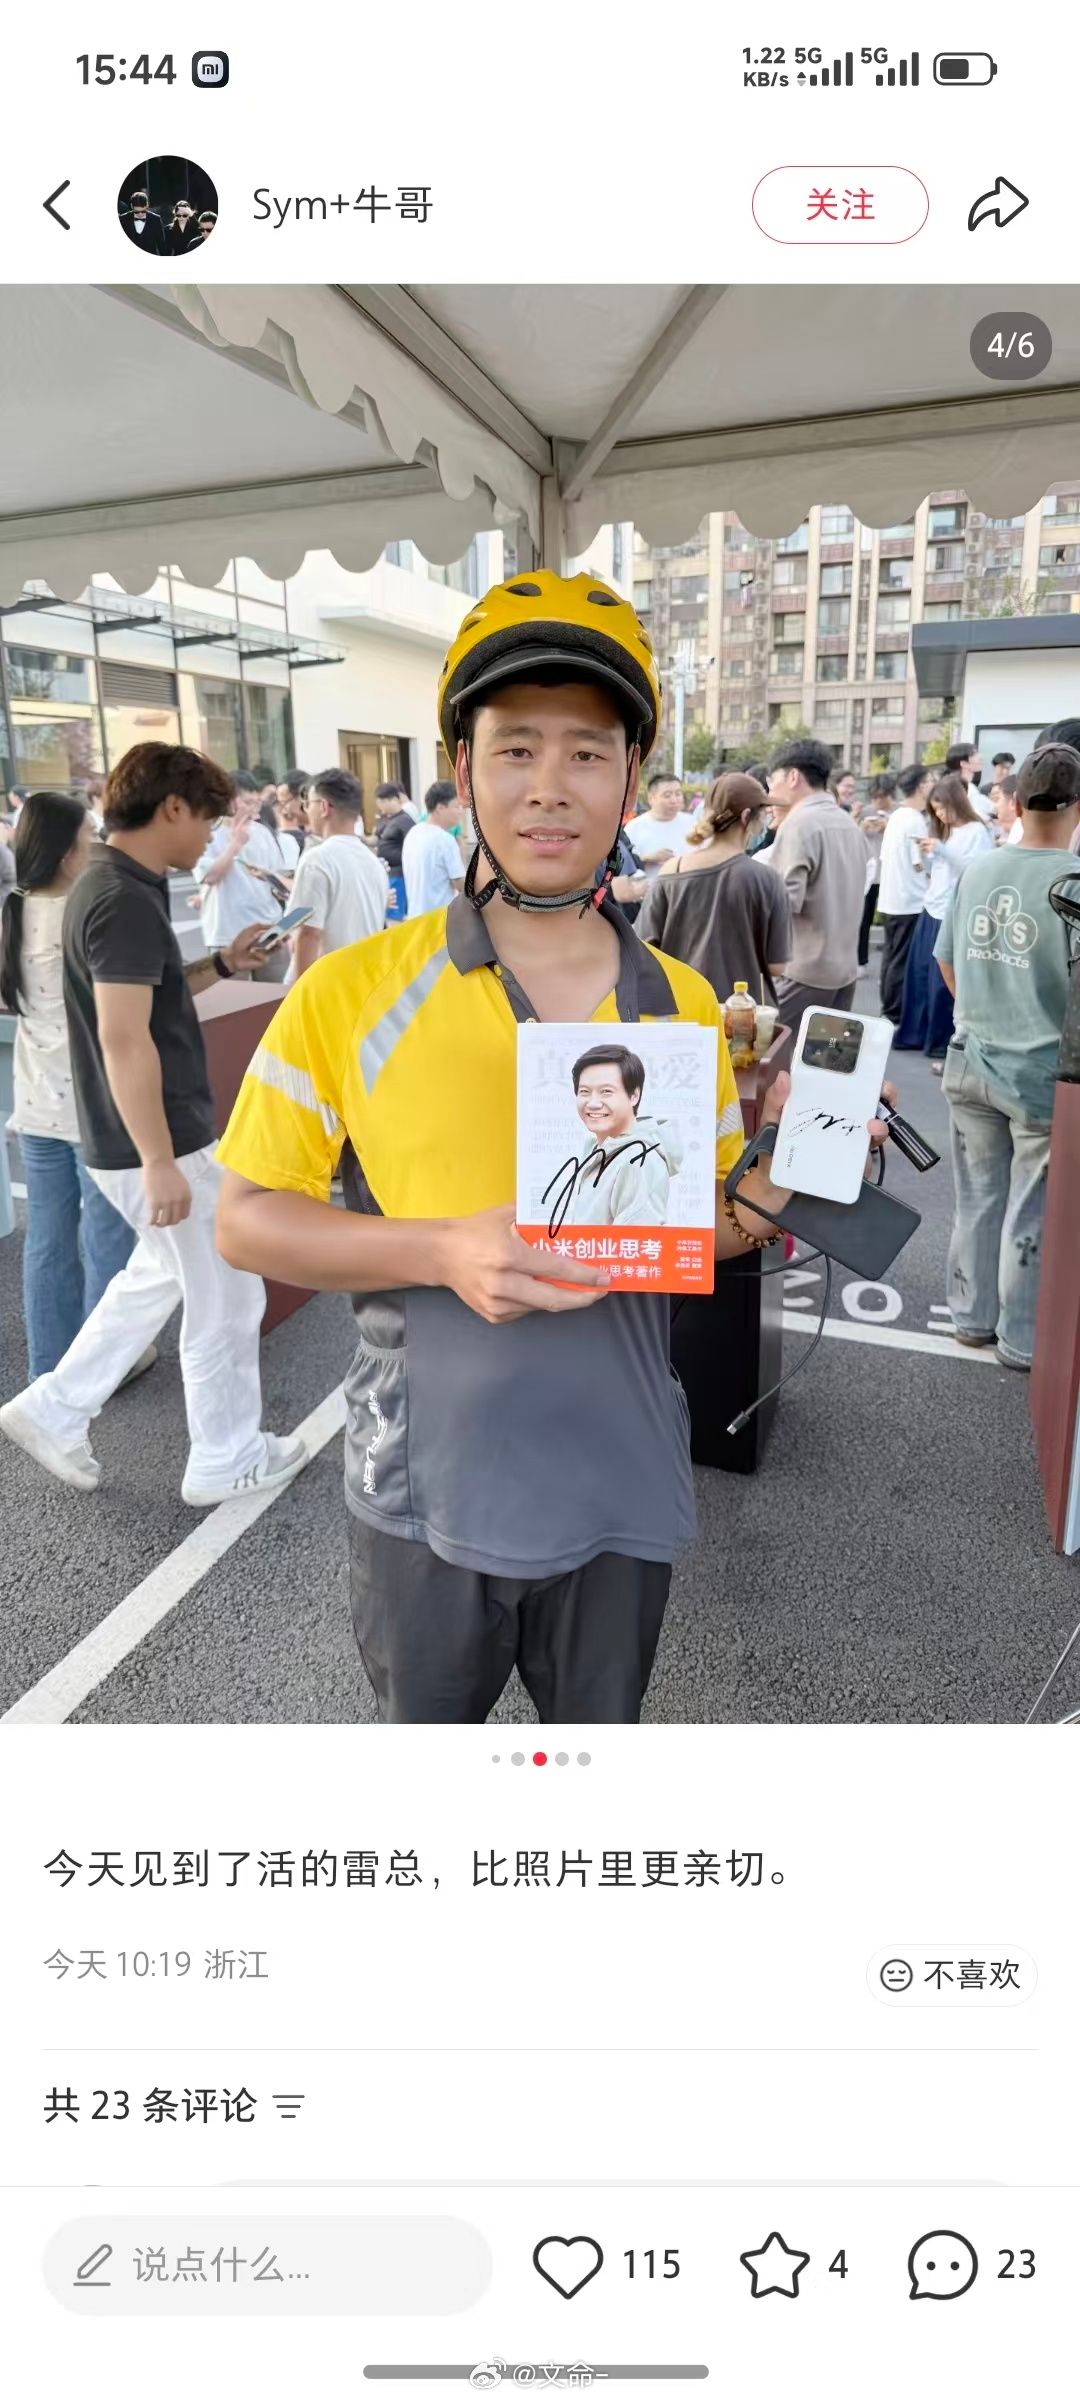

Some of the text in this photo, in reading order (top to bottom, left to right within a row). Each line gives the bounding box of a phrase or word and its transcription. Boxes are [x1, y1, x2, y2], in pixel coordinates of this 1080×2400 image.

[533, 1238, 663, 1260] 小米创业思考
